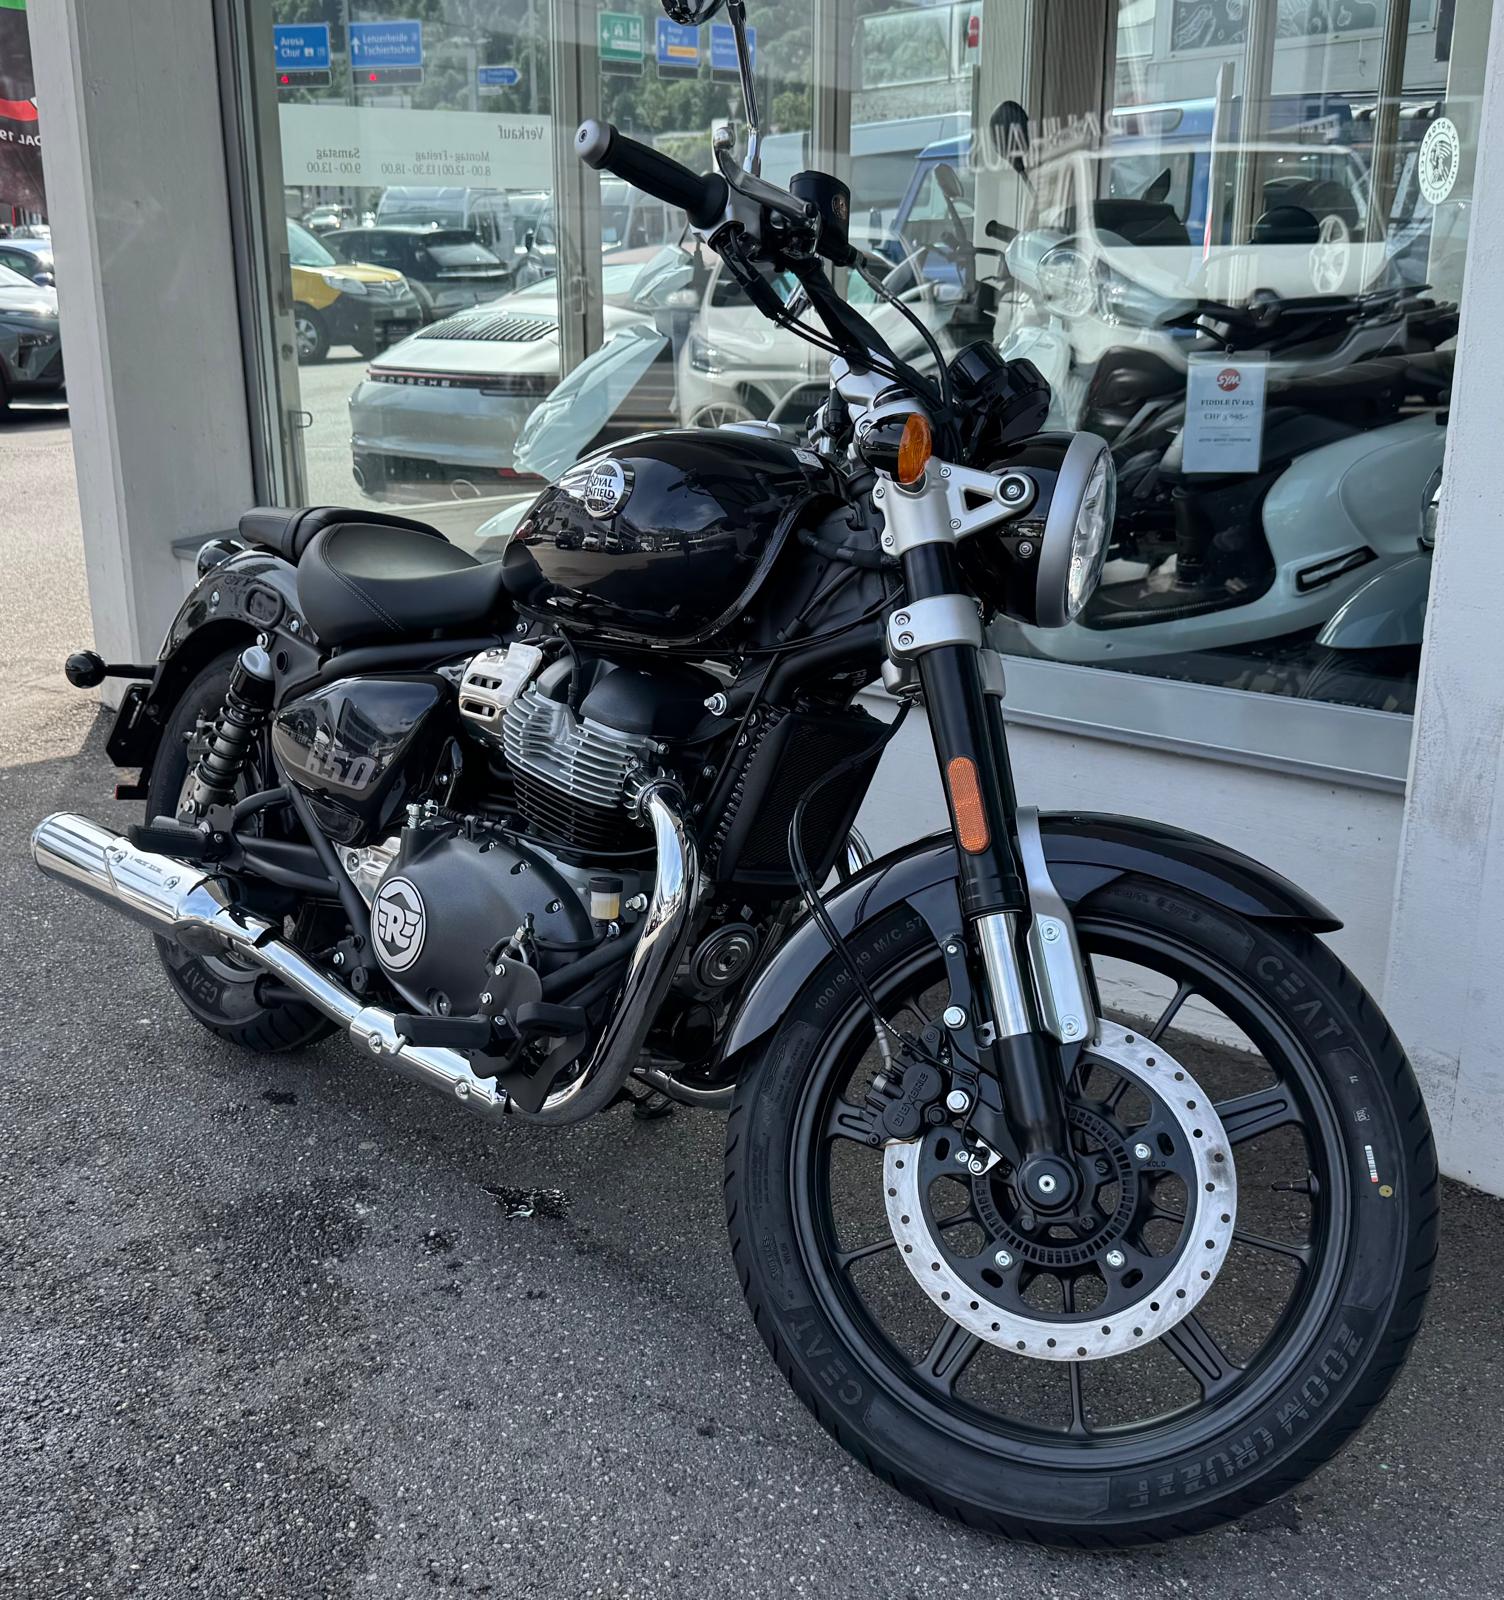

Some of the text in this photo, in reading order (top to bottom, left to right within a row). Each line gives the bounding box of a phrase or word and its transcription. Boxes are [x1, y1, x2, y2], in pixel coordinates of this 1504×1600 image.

[281, 48, 300, 57] Chur
[1216, 375, 1241, 387] SYM
[585, 484, 617, 500] ENFIELD
[588, 473, 614, 488] ROYAL
[305, 747, 375, 791] 650
[872, 928, 903, 953] M/C
[181, 965, 218, 1003] CEAT
[1256, 955, 1344, 1041] CEAT
[789, 1315, 864, 1405] CEAT
[1275, 1324, 1365, 1436] ZOOM
[1180, 1425, 1276, 1495] CRUZ
